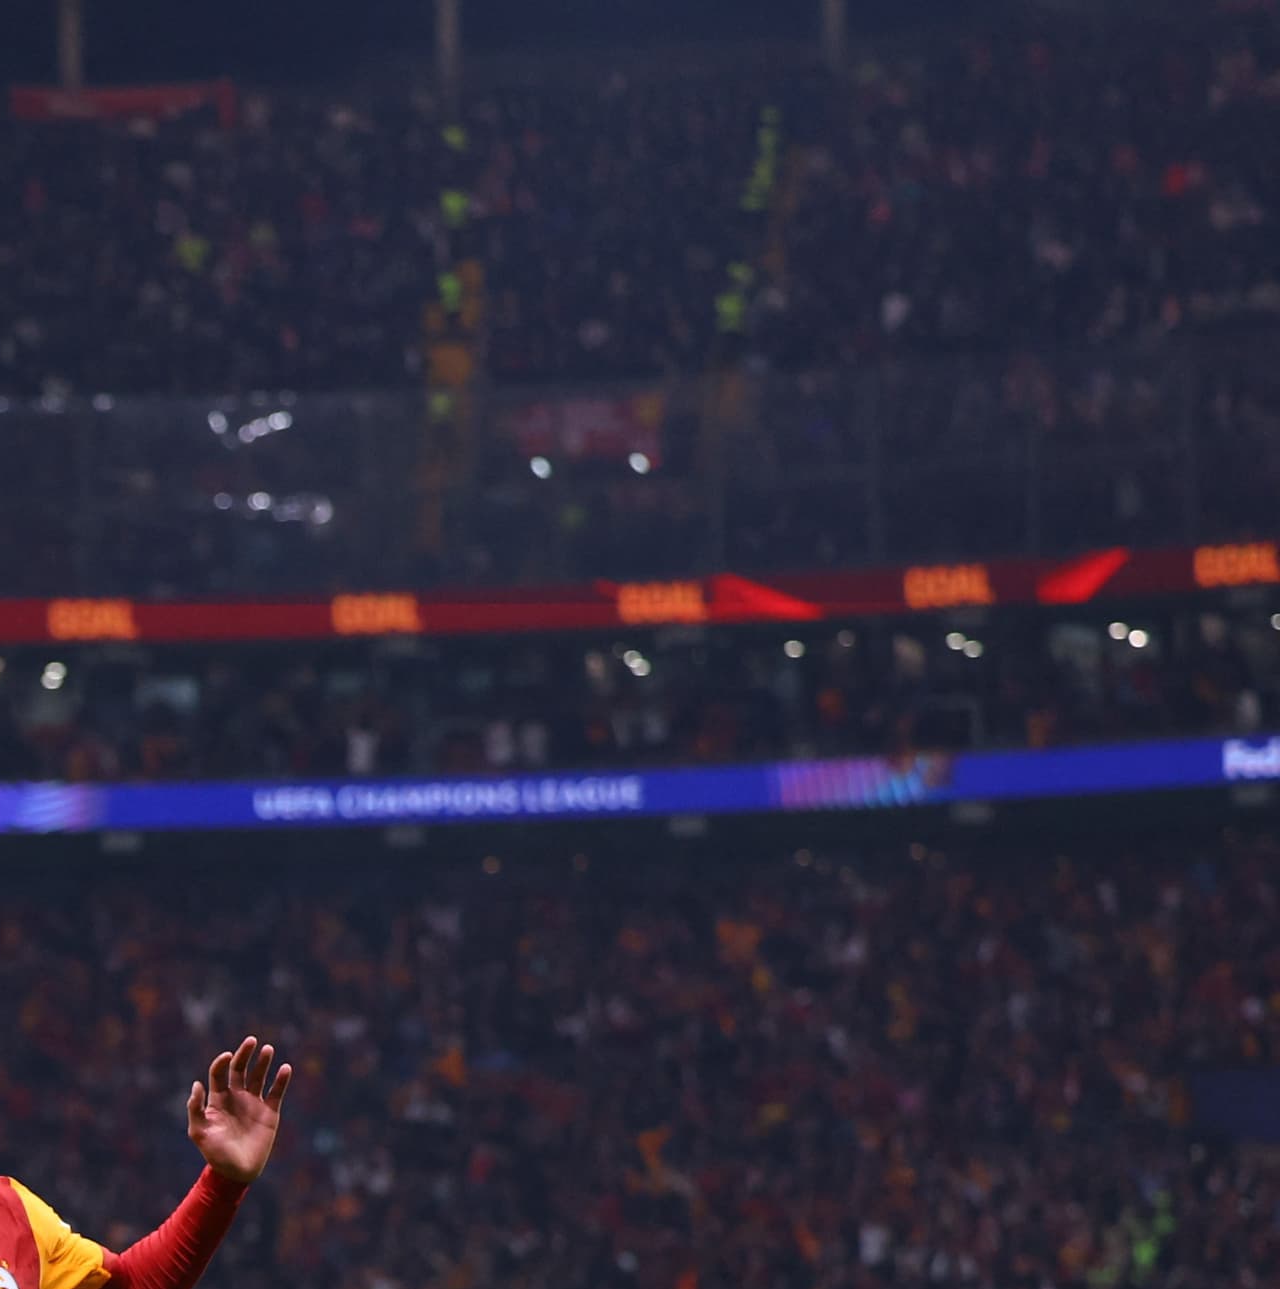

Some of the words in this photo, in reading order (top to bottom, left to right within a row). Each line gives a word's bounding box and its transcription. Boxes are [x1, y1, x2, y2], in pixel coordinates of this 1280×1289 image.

[253, 786, 334, 821] UEFA
[338, 781, 519, 820] CHAMPIONS
[522, 776, 640, 812] LEAGUE
